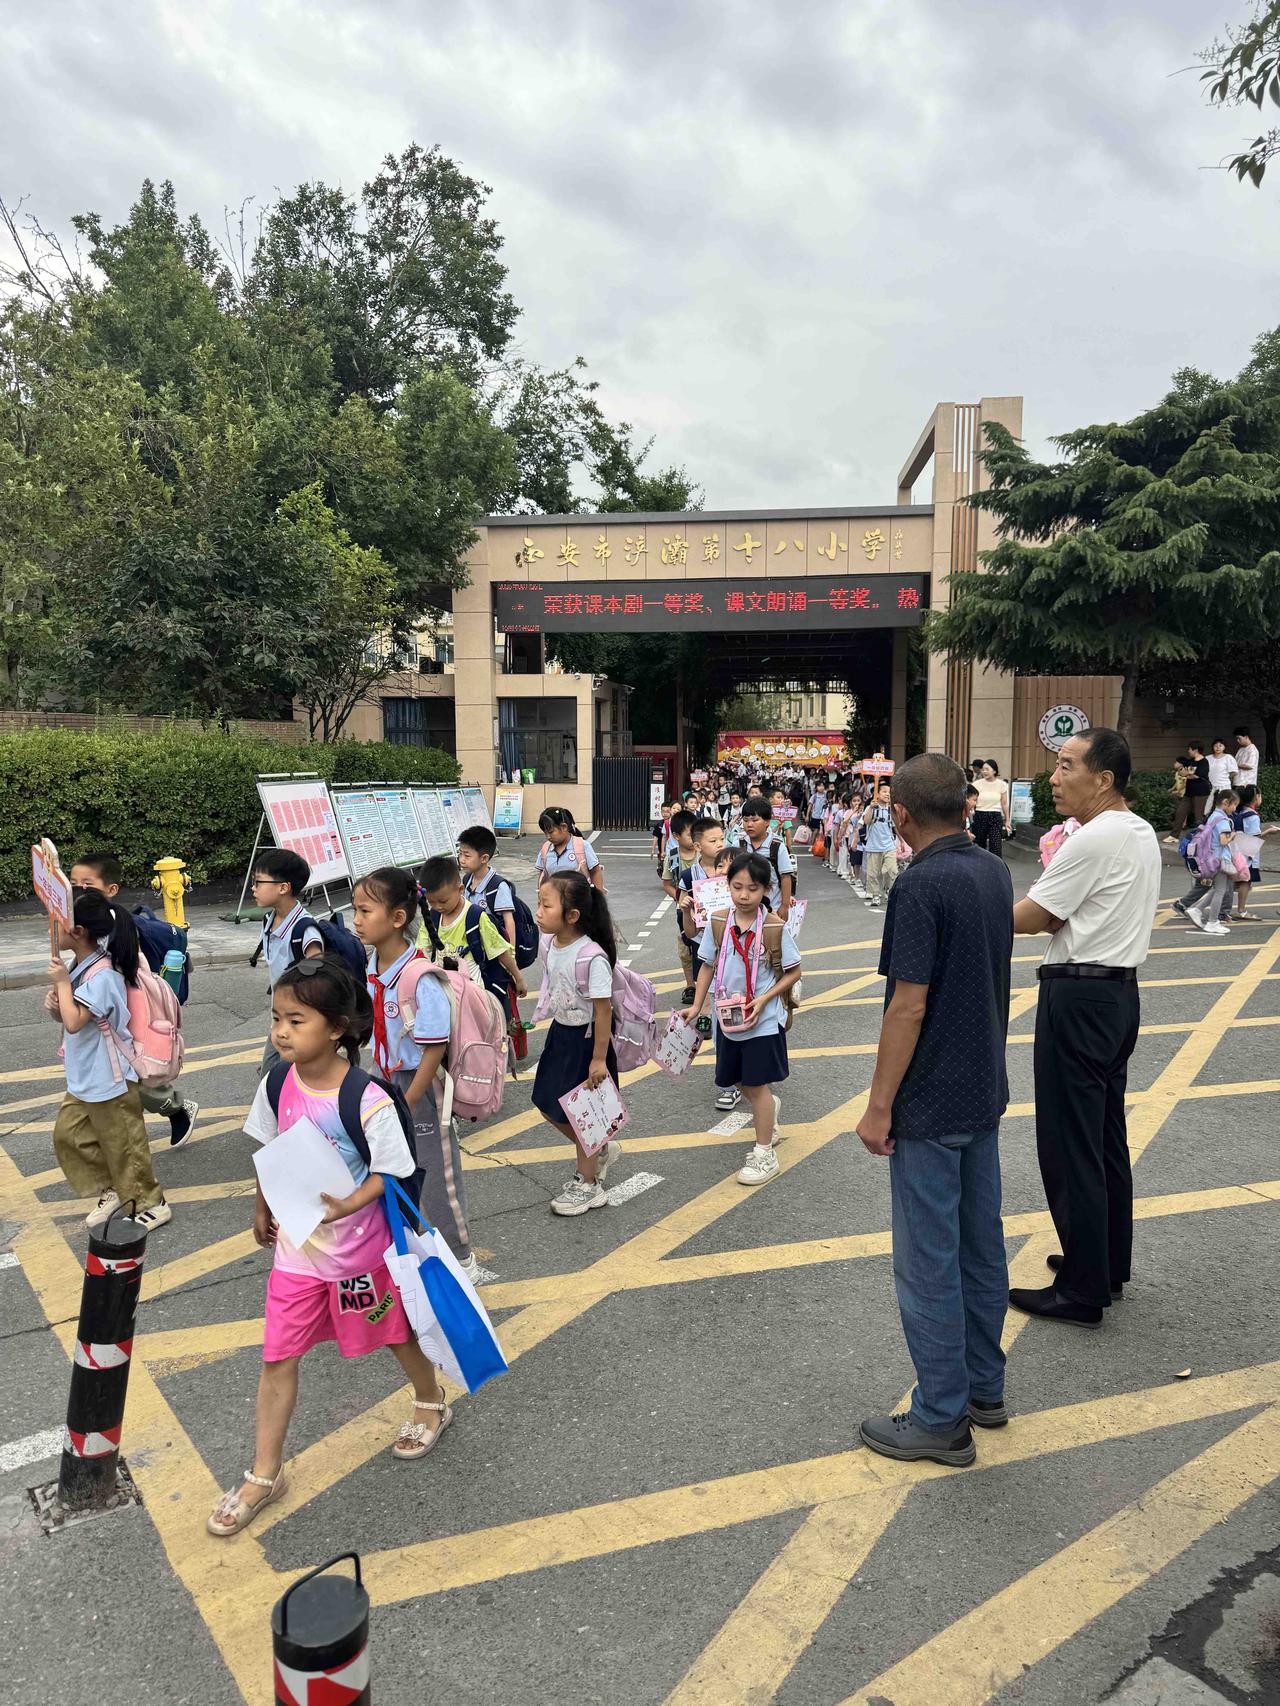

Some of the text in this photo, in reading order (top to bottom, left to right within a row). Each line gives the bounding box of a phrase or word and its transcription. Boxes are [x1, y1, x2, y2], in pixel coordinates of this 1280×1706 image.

[340, 1274, 370, 1291] WS
[341, 1293, 374, 1310] MD
[368, 1294, 393, 1322] PARIS
